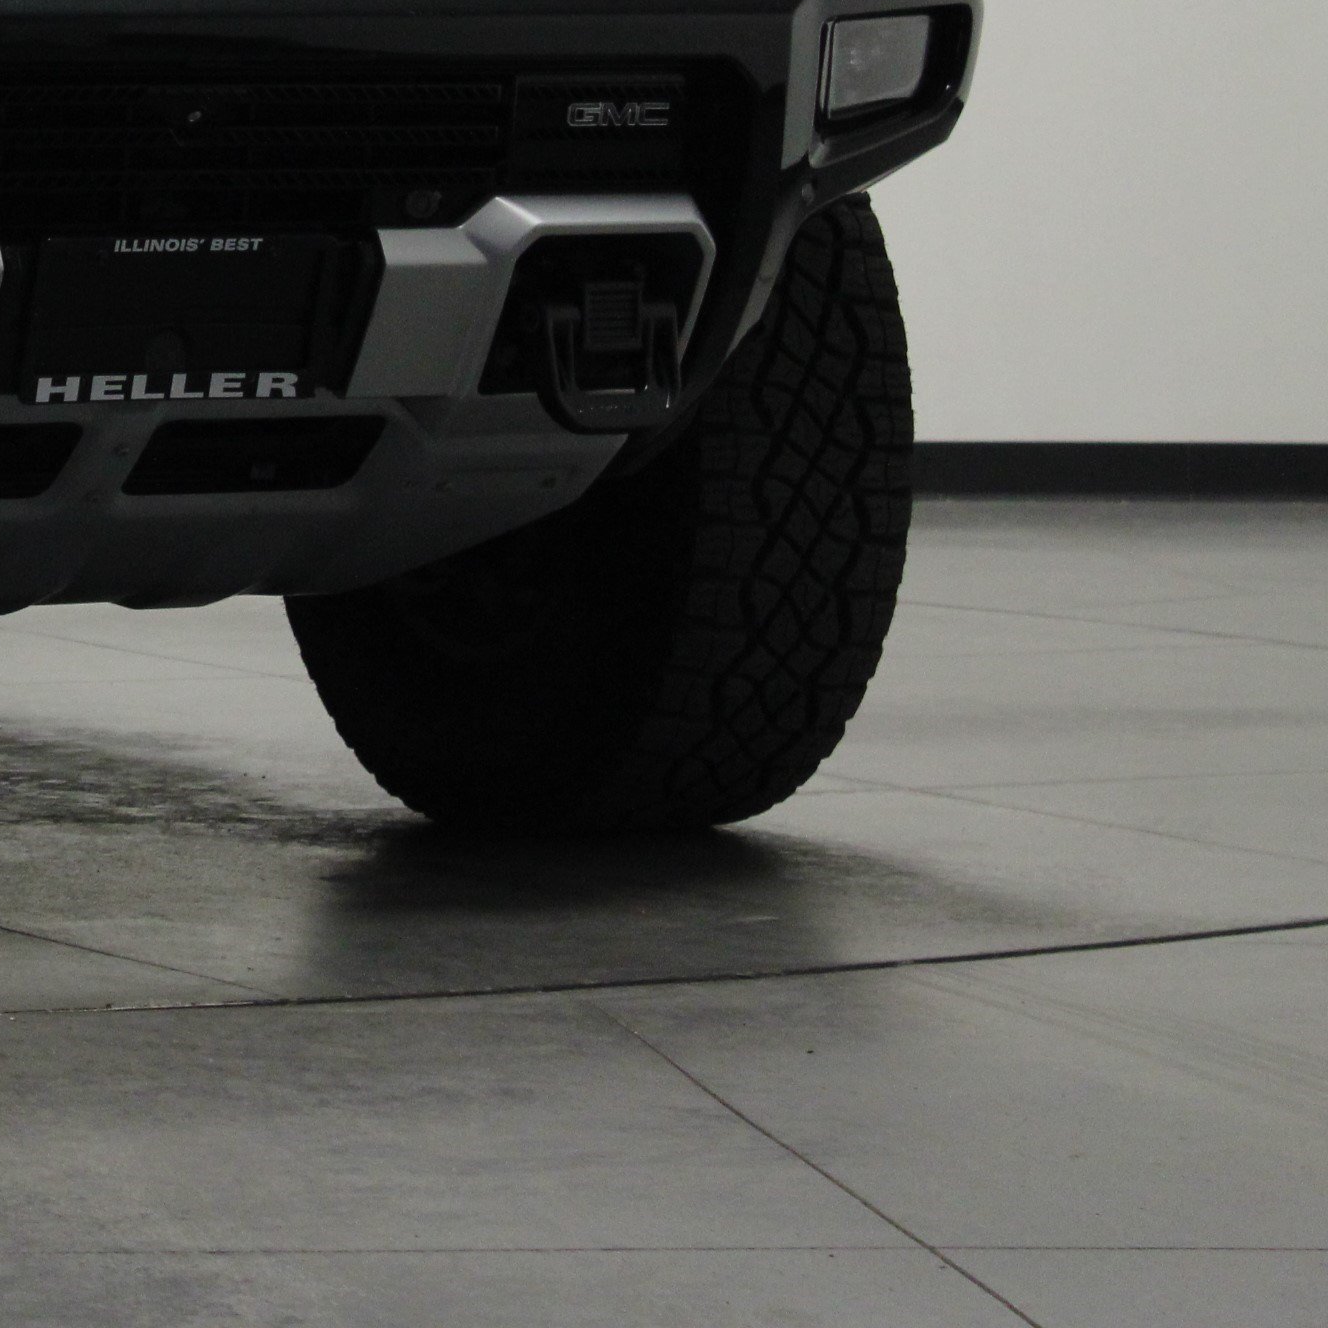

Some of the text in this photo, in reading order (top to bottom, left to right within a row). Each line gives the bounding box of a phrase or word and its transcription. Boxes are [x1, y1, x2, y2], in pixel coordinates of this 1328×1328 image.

[566, 101, 670, 128] GMC
[209, 237, 264, 252] BEST
[35, 371, 299, 403] HELLER
